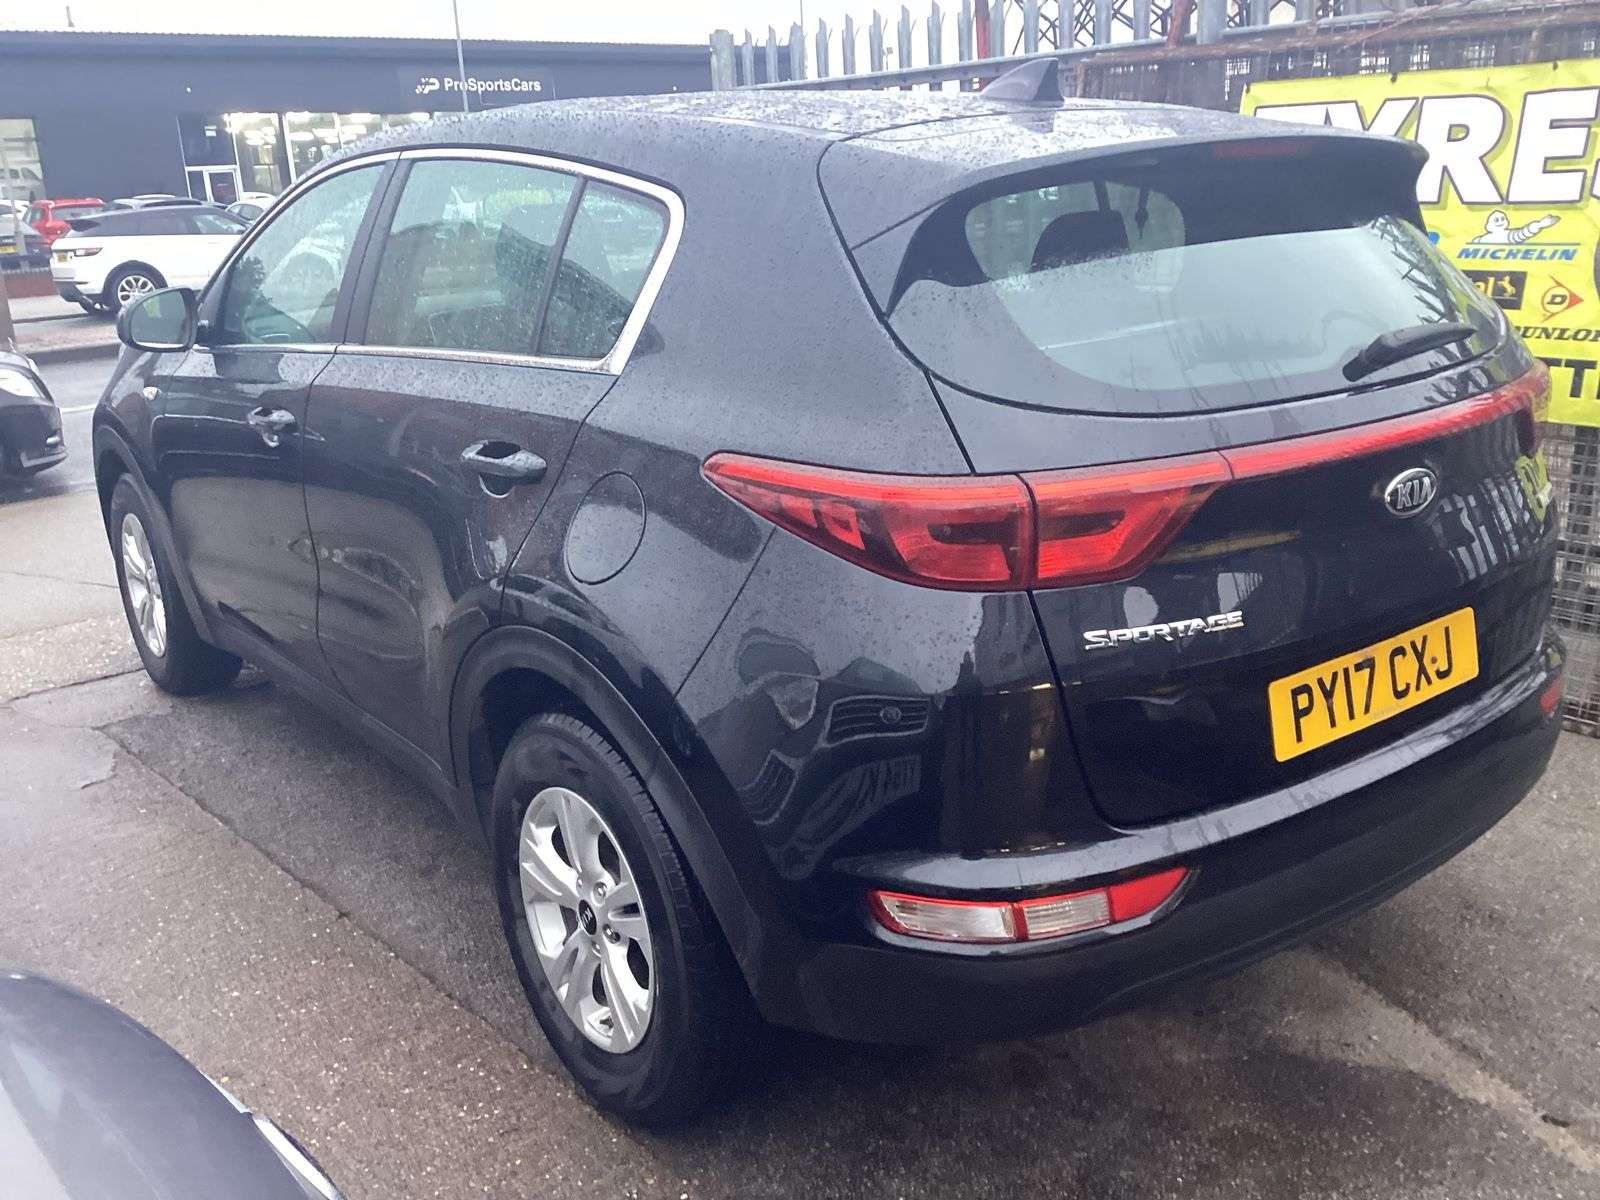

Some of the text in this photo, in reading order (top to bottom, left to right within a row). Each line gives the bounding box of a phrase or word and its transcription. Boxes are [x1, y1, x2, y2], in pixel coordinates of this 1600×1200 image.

[444, 78, 542, 94] ProSportsCars
[1456, 247, 1578, 261] MICHELIN
[1513, 325, 1600, 342] UNLO
[1396, 476, 1432, 509] KIA
[1083, 610, 1245, 650] SPORTAGE
[1290, 625, 1454, 743] PY17 CXJ
